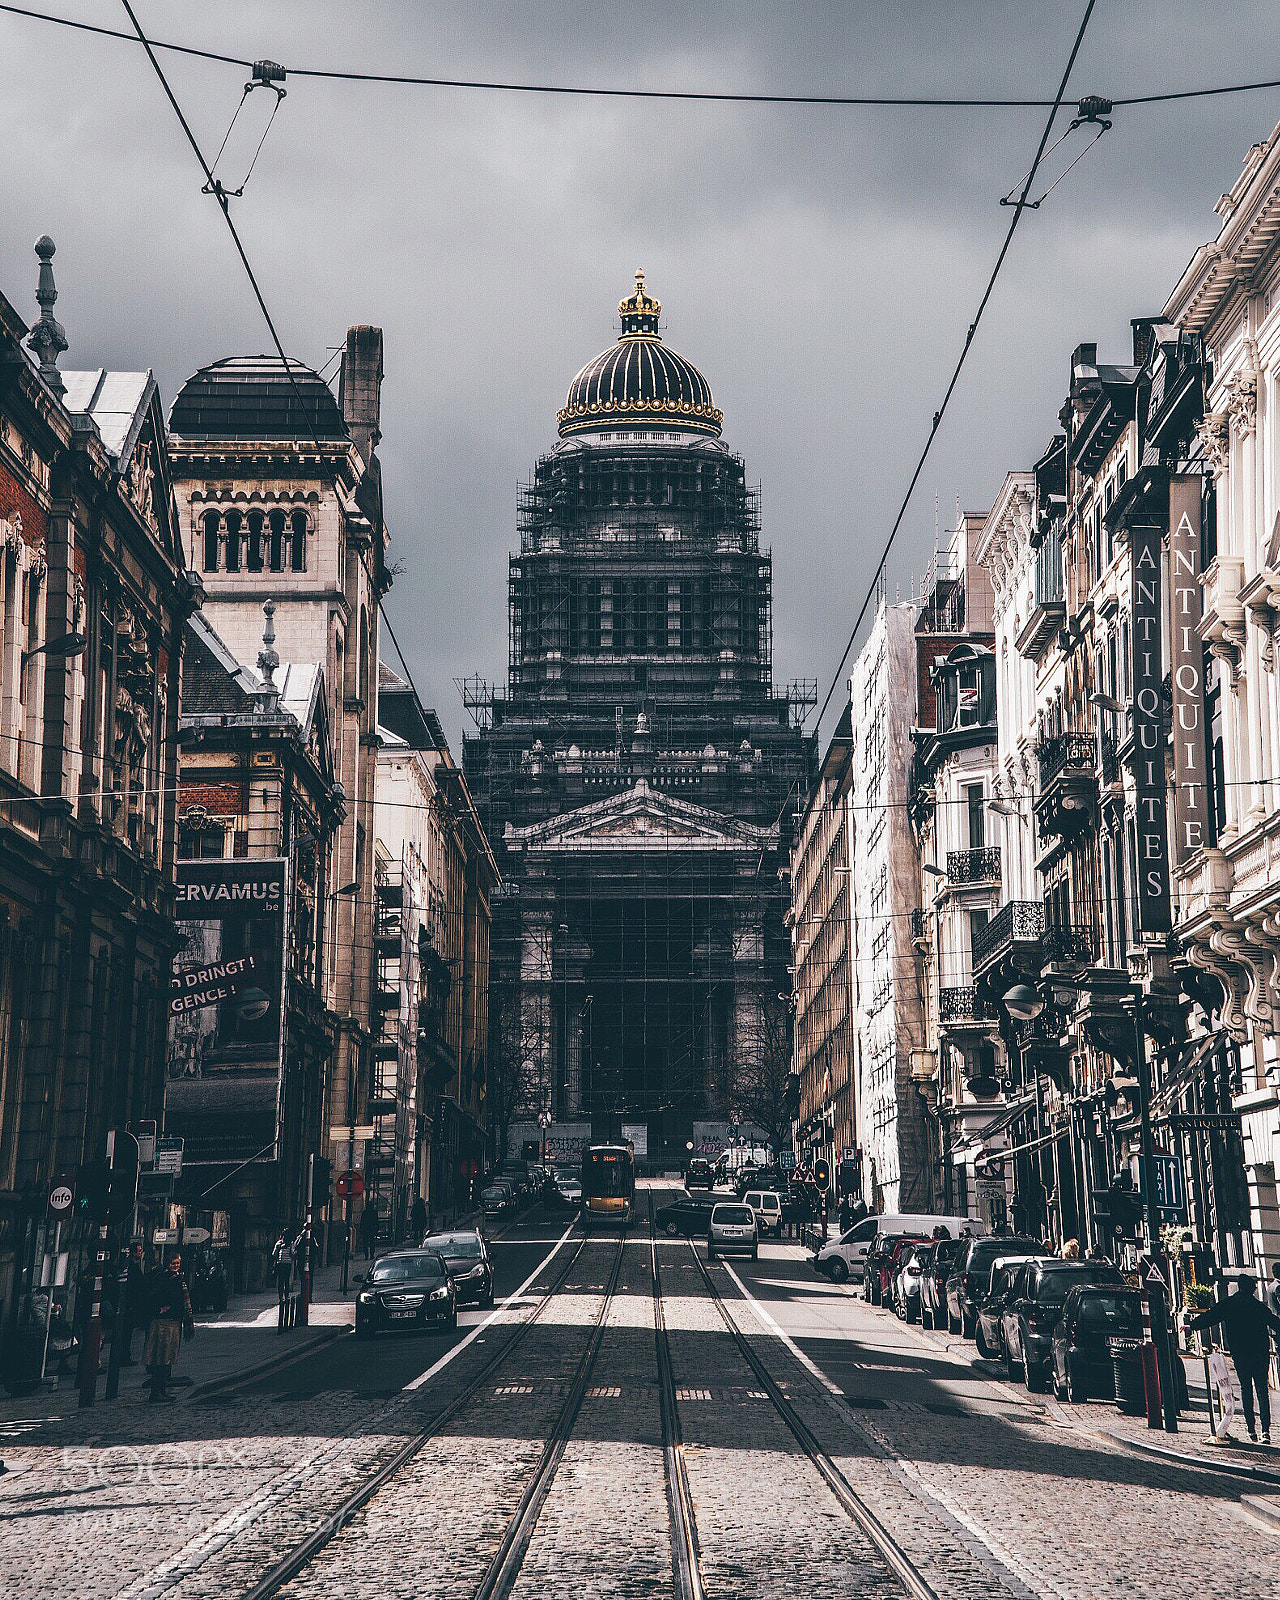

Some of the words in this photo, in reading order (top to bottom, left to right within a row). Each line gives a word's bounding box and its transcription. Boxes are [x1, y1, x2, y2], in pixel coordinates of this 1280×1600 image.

[1136, 544, 1162, 897] ANTIQUITES
[1174, 511, 1204, 849] ANTIQUITE
[185, 959, 245, 987] DRINGT
